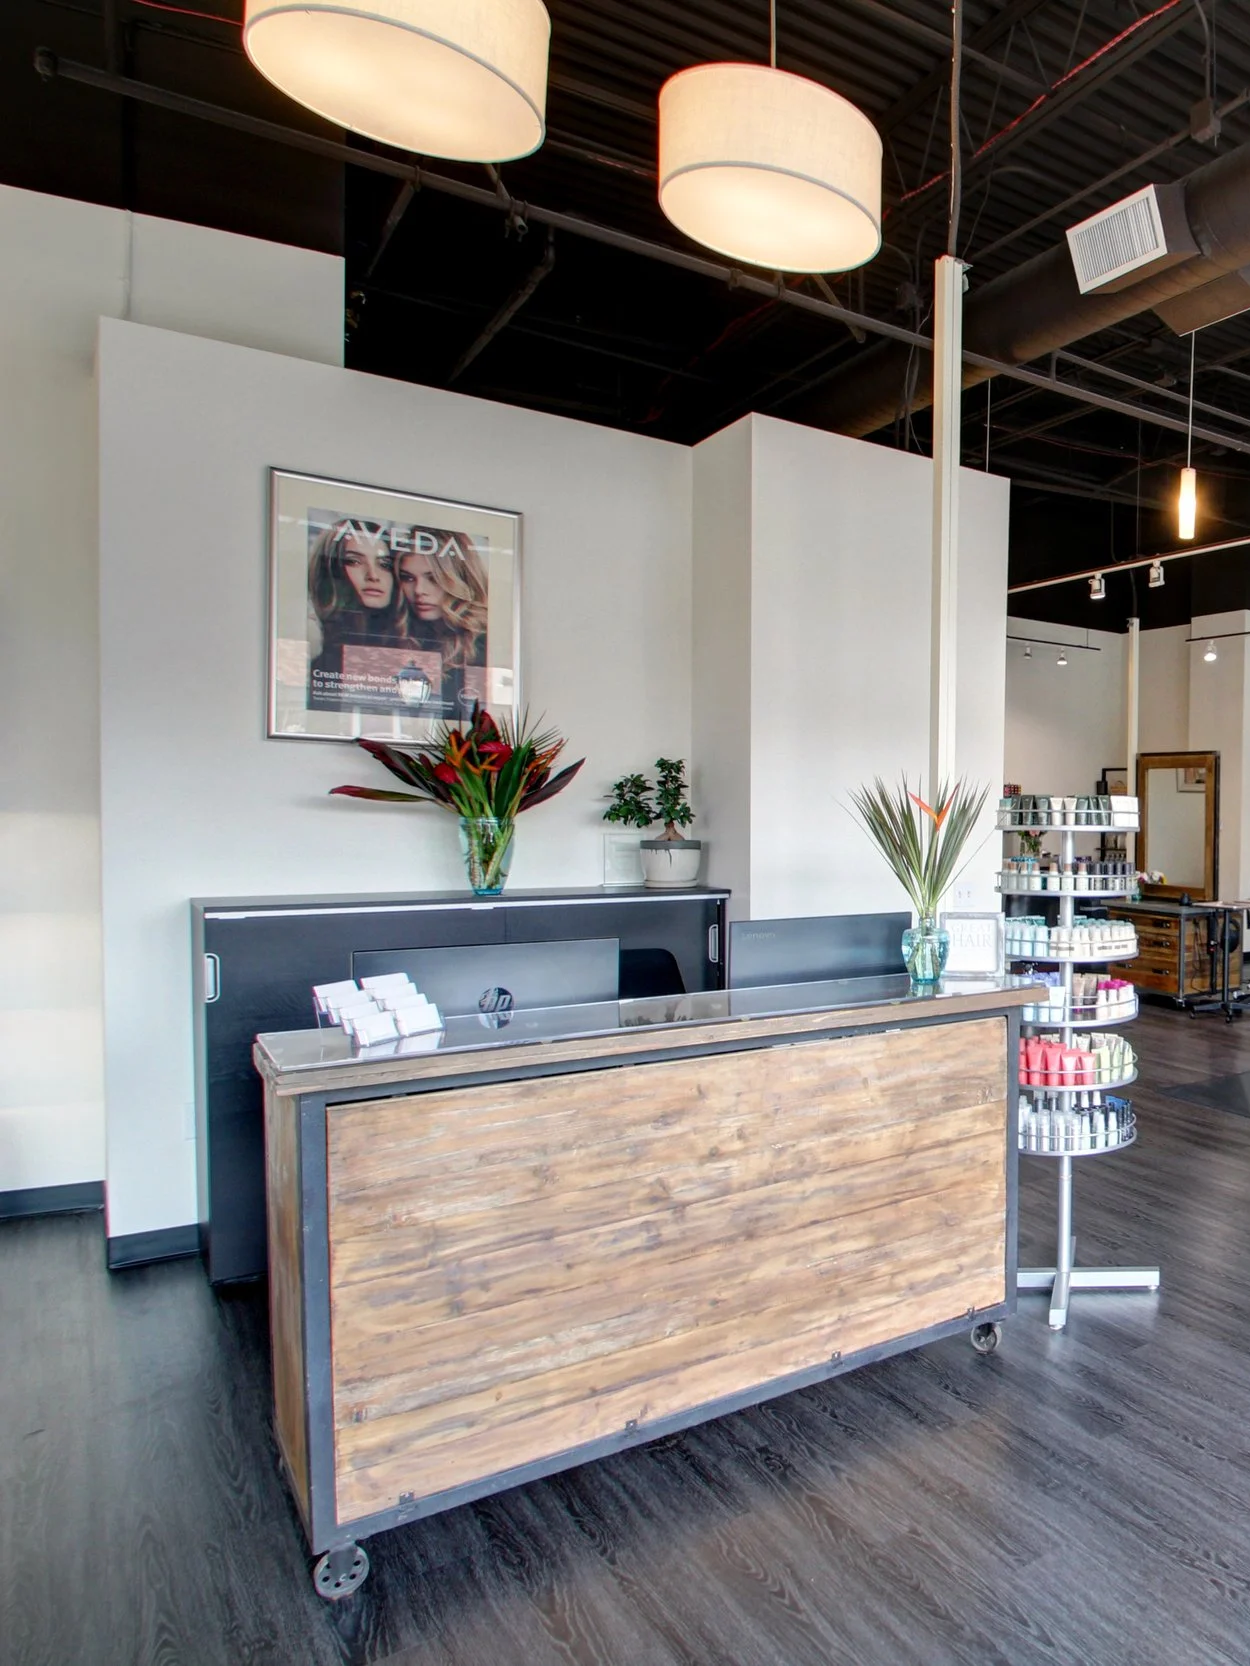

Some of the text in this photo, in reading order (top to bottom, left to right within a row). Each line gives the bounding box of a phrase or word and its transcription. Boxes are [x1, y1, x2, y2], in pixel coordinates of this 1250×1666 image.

[333, 519, 465, 561] AVEDA
[313, 669, 345, 679] Create
[367, 673, 397, 684] bonds
[313, 680, 323, 688] to
[324, 680, 378, 692] strengthen
[952, 933, 993, 948] HAIR
